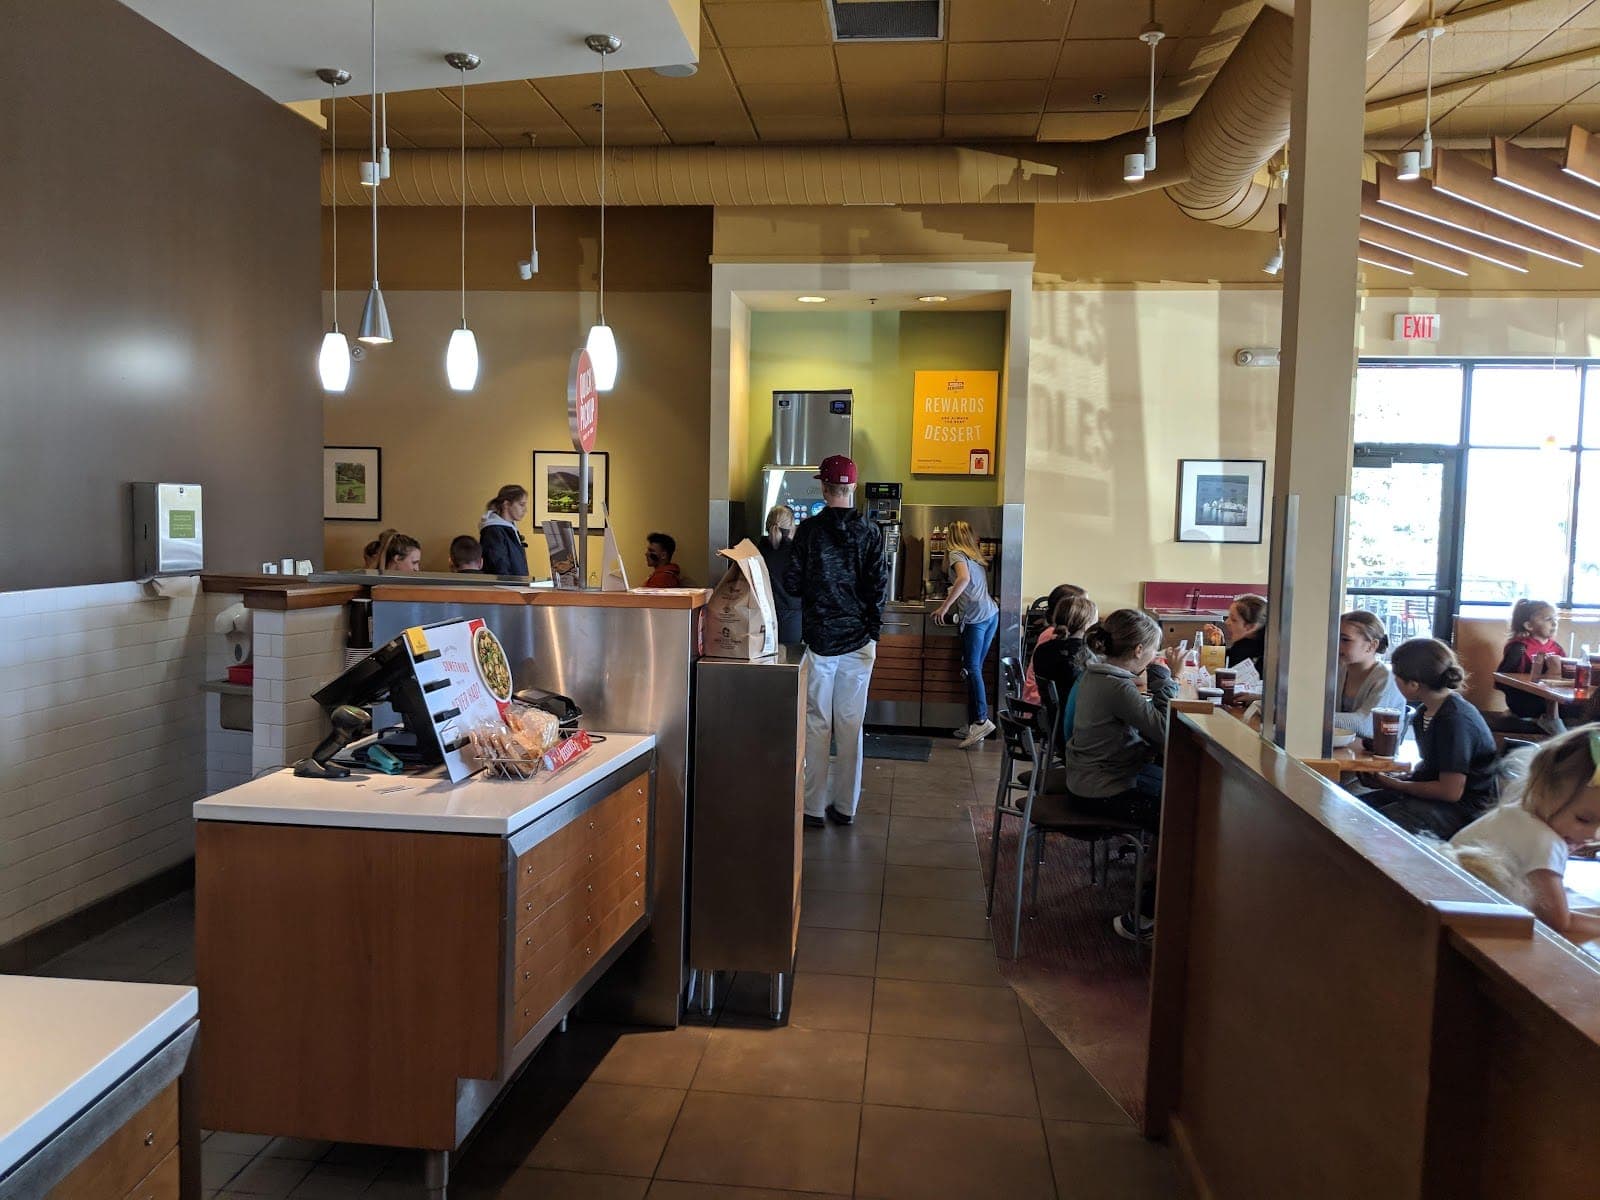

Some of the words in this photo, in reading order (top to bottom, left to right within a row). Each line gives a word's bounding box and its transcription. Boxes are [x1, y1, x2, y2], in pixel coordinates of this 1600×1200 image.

[1404, 316, 1434, 338] EXIT
[925, 397, 984, 413] REWARDS
[924, 425, 982, 442] DESSERT
[442, 660, 470, 672] SOMETHING
